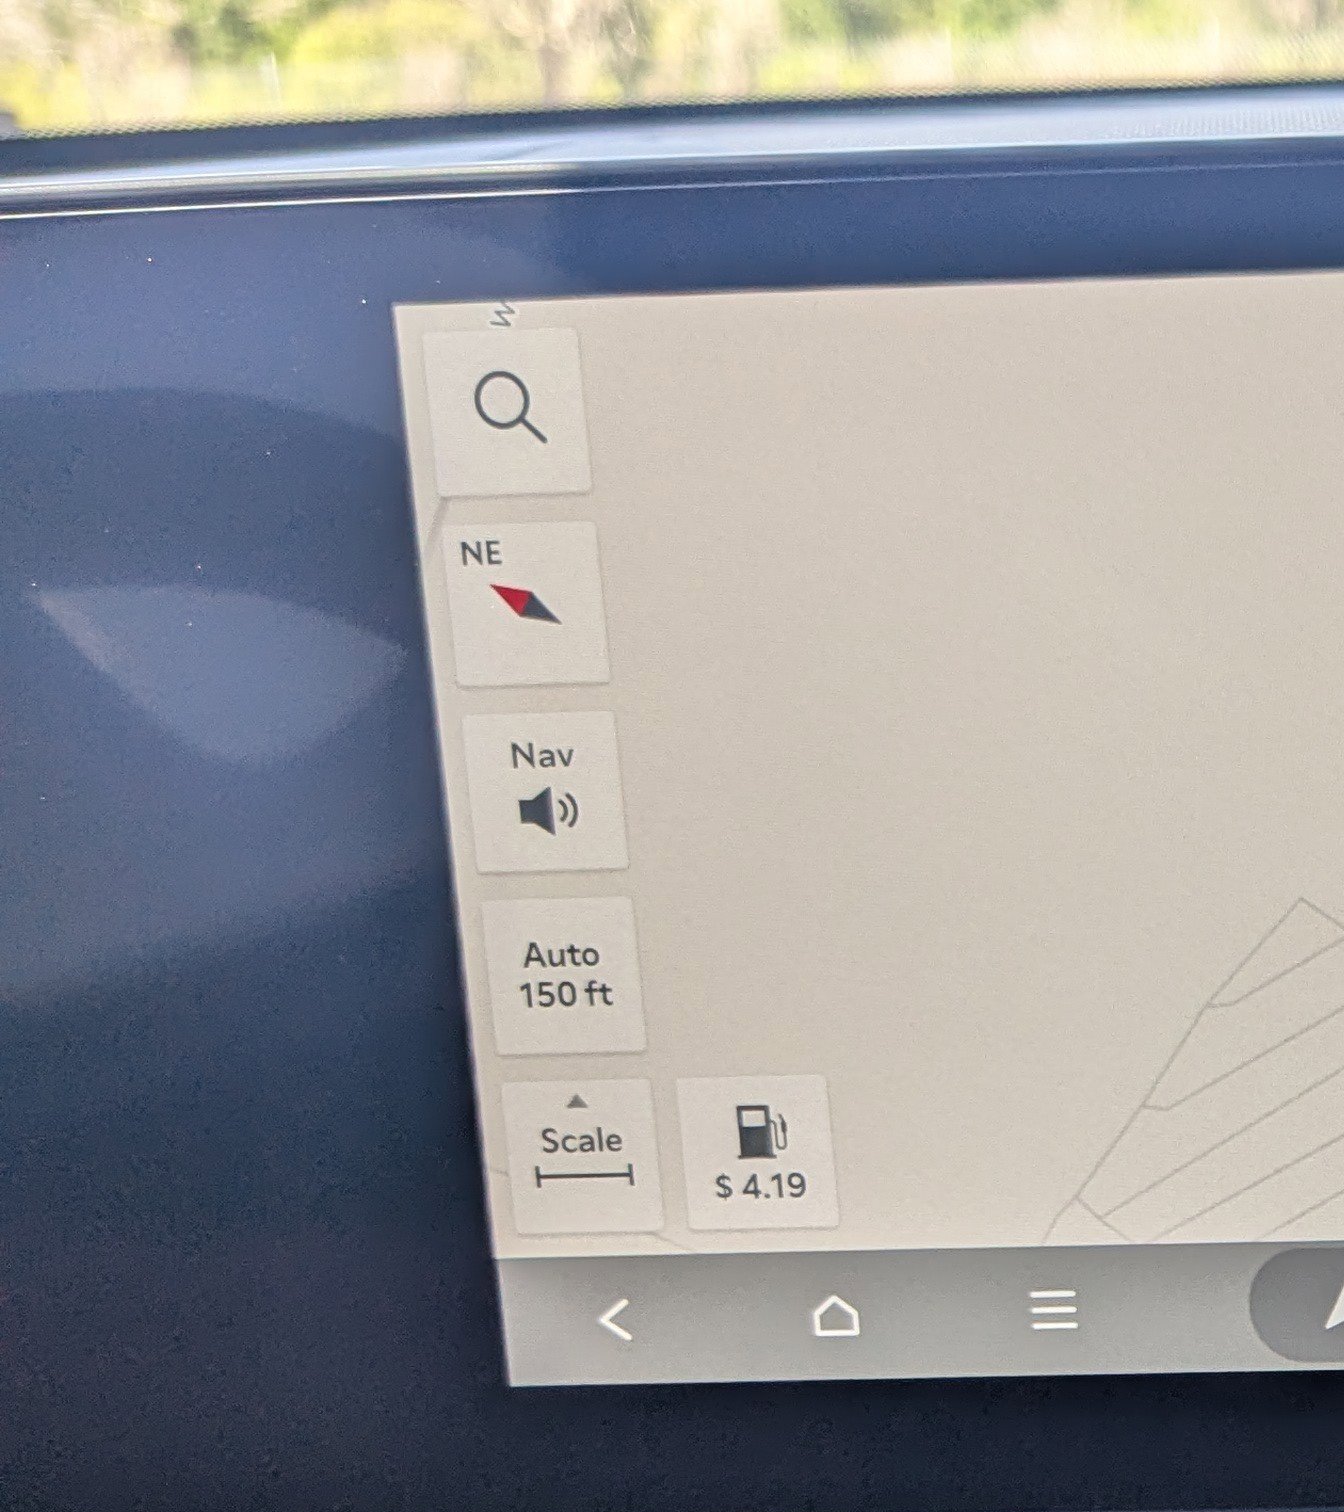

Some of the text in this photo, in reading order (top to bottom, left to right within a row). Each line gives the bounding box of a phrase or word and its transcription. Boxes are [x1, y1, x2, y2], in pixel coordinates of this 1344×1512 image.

[459, 540, 503, 566] NE
[510, 742, 574, 769] Nav
[523, 942, 601, 969] Auto
[518, 980, 614, 1009] 150 ft
[541, 1126, 623, 1154] Scale
[742, 1172, 808, 1200] 4.19
